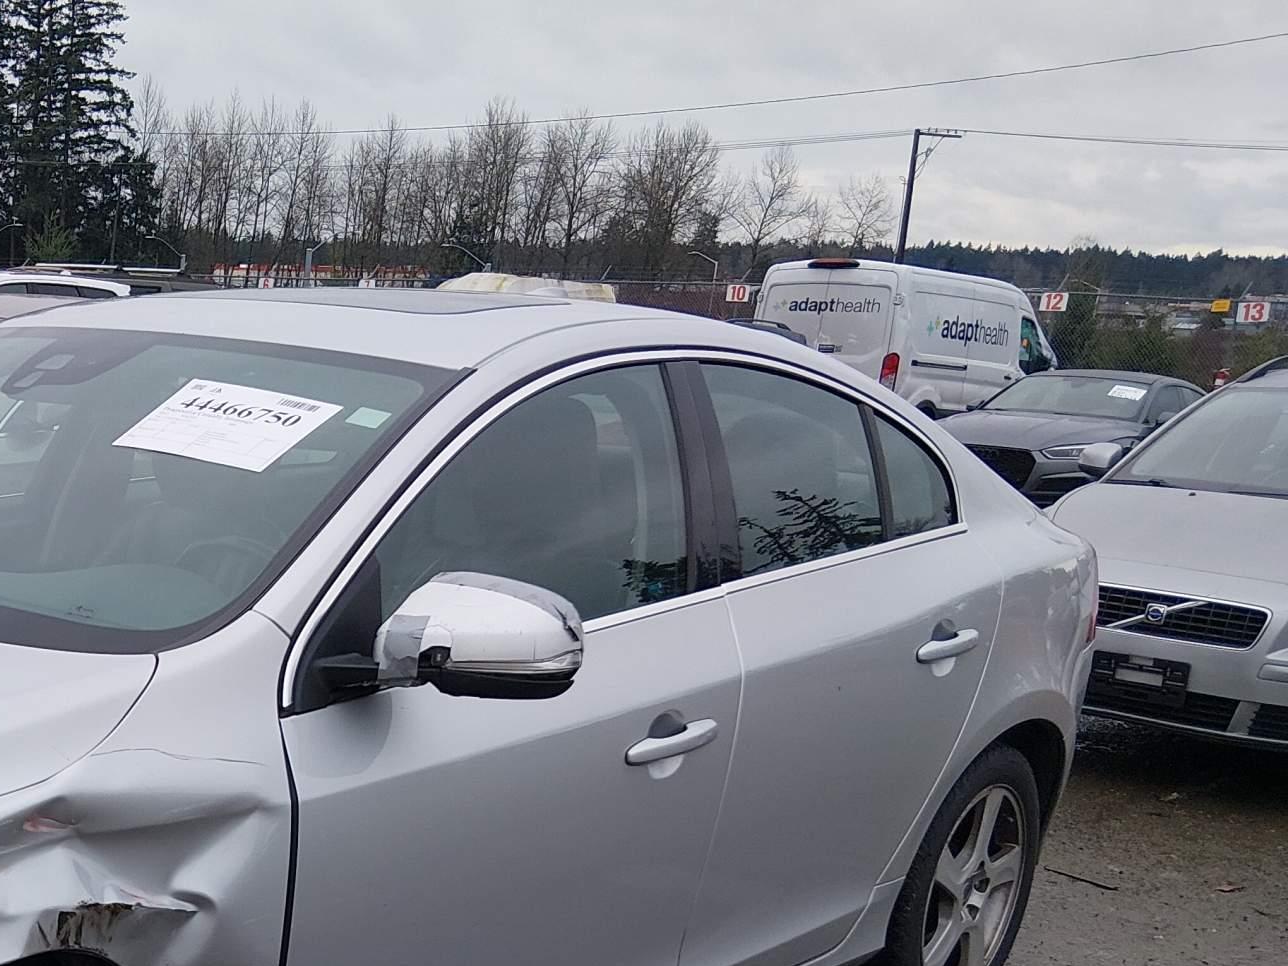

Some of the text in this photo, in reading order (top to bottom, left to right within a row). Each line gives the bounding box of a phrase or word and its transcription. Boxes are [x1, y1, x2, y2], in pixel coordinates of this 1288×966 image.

[730, 285, 747, 301] 10
[1045, 293, 1064, 310] 12
[788, 297, 881, 315] adapthealth
[1243, 302, 1265, 322] 13
[941, 314, 1009, 348] adapthealth
[180, 396, 303, 428] 44466750
